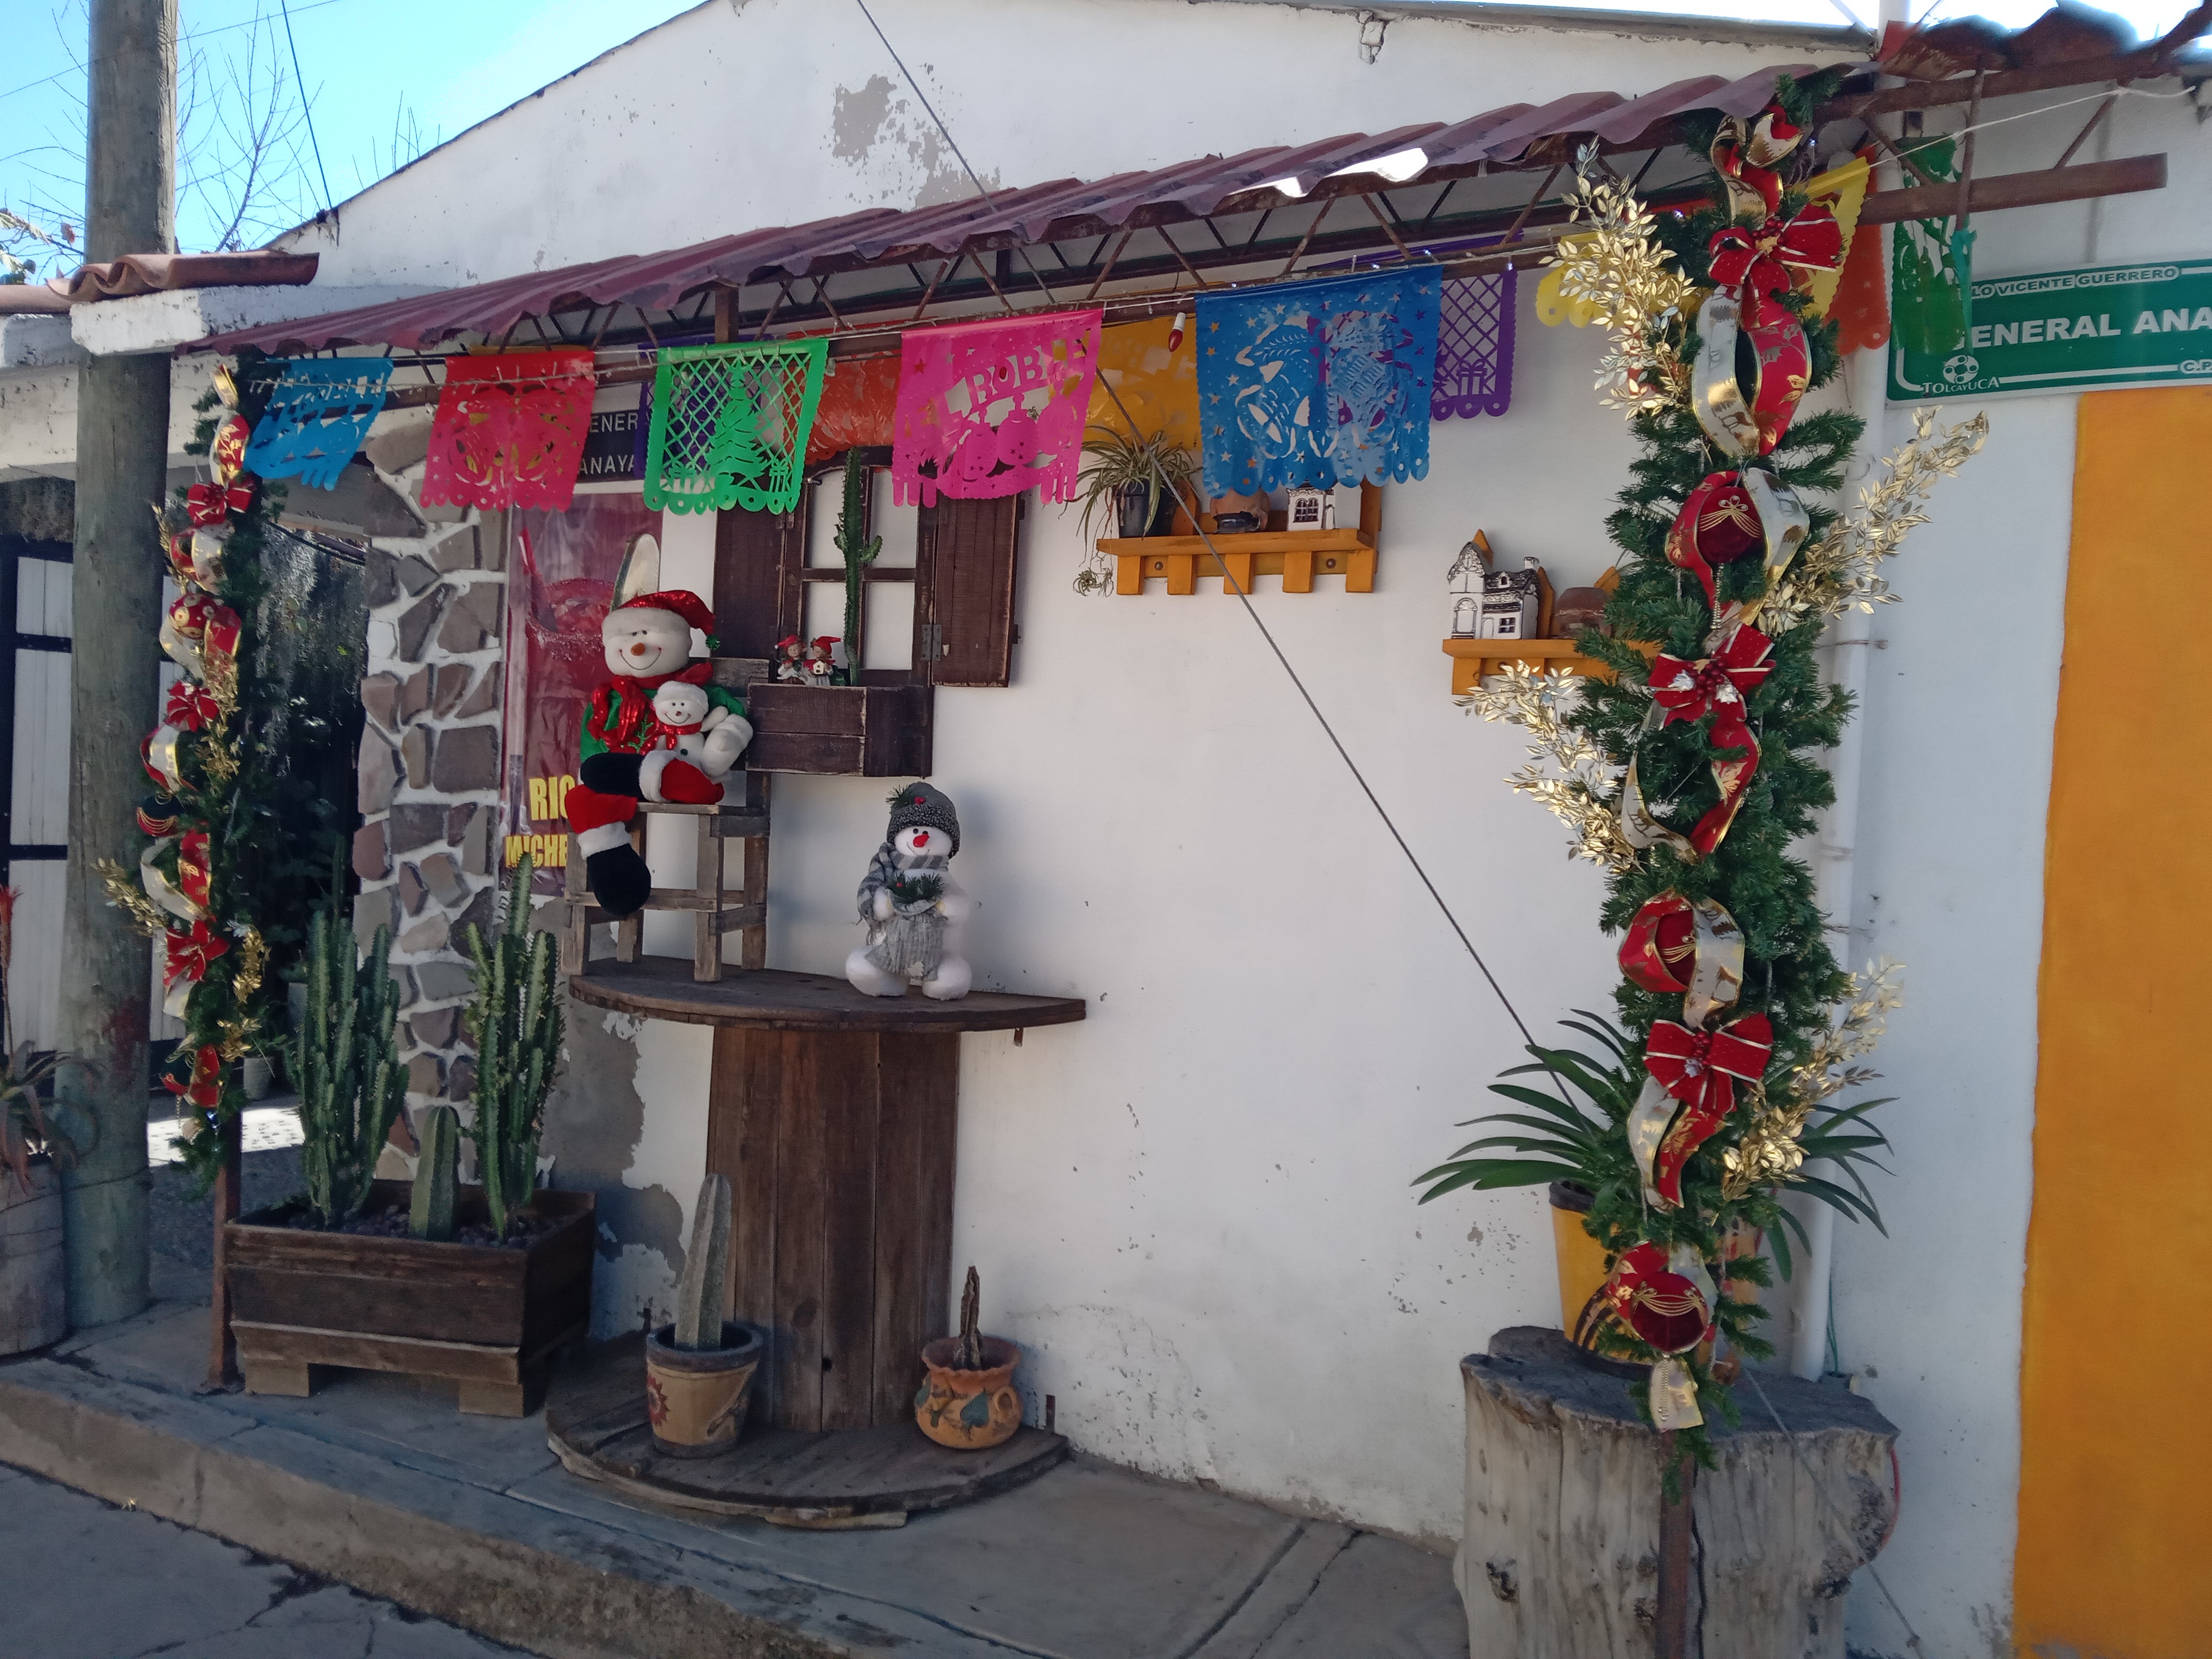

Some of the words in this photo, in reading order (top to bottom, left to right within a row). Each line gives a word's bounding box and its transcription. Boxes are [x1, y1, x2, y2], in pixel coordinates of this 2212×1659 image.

[1972, 286, 1992, 296] LO
[1998, 276, 2072, 295] VICENTE
[2079, 268, 2176, 285] GUERRERO
[1953, 313, 2122, 350] ENERAL
[2133, 306, 2212, 334] ANA
[1923, 376, 2000, 394] TOLCAYUCA
[589, 412, 639, 434] ENER
[529, 774, 575, 820] RIC
[506, 834, 568, 868] MICHE
